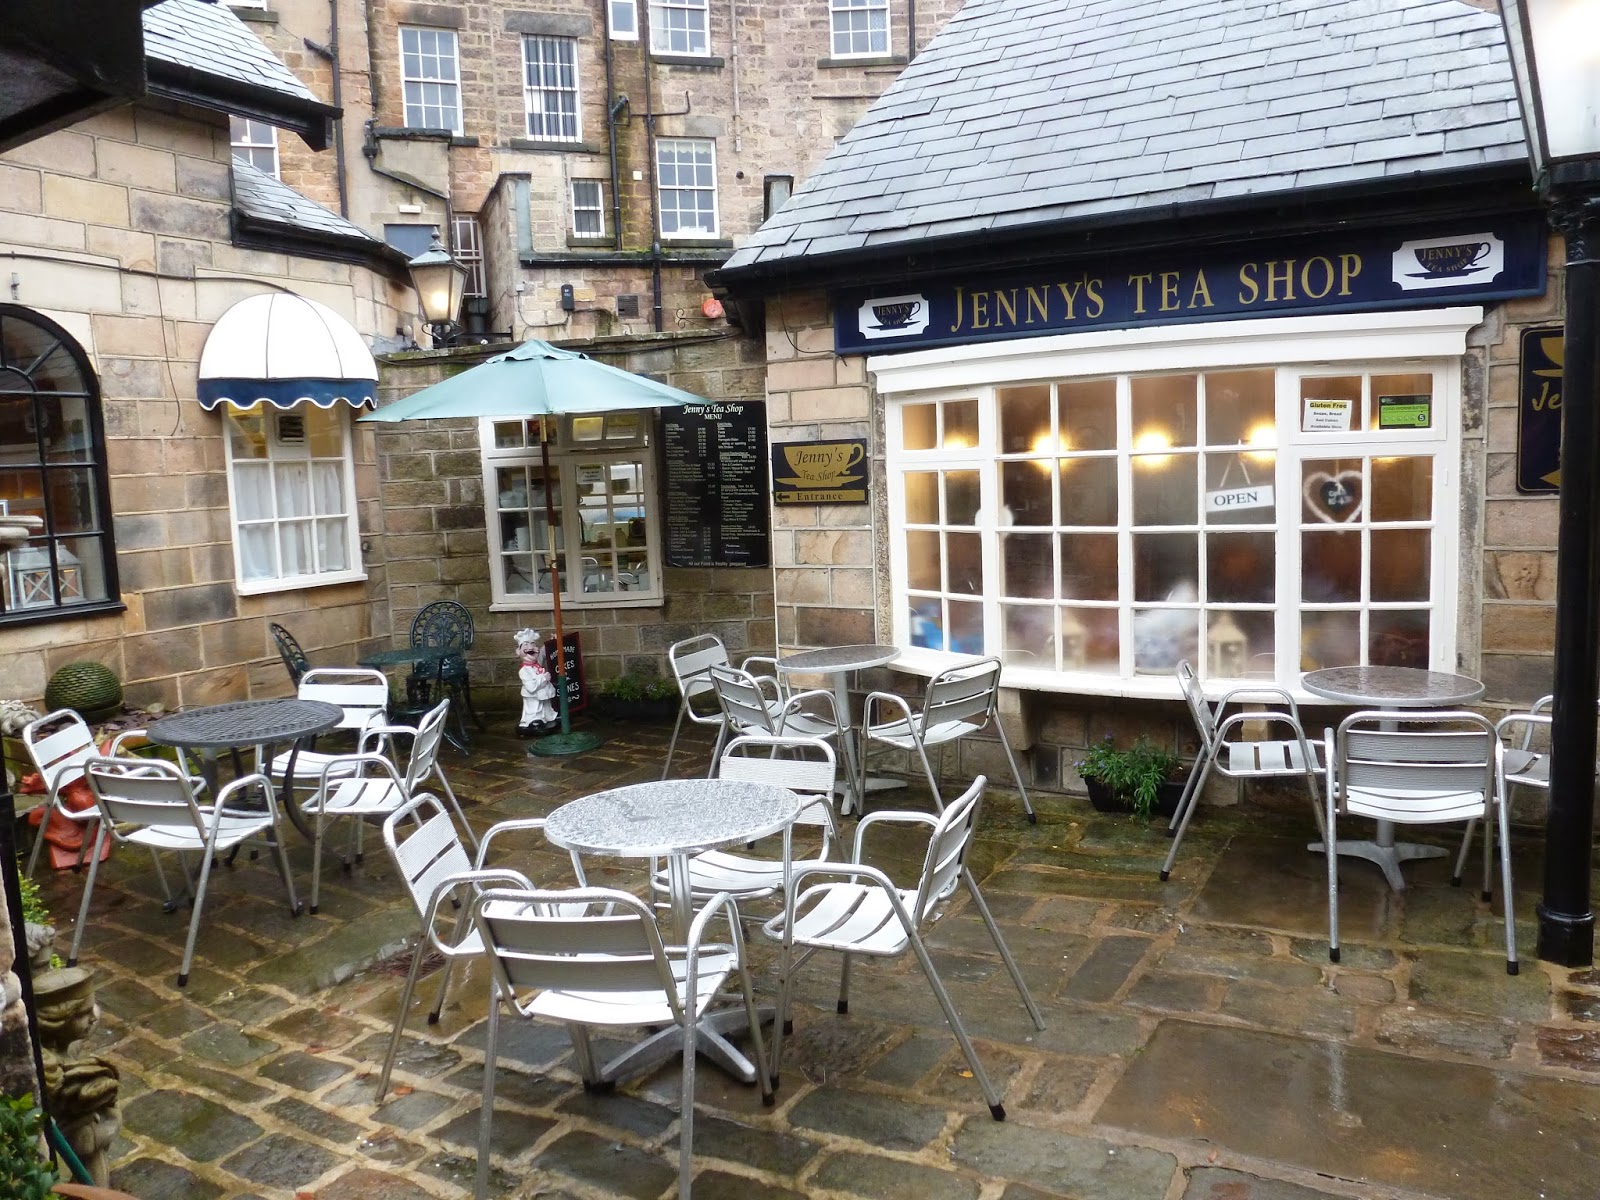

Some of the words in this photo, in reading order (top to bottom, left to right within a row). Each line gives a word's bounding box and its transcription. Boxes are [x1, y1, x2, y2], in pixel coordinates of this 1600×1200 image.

[1421, 245, 1473, 261] JENNY'S
[951, 272, 1104, 333] JENNY'S
[1128, 268, 1215, 314] TEA
[1238, 253, 1363, 305] SHOP
[877, 304, 910, 316] JENNY'S
[1531, 381, 1563, 411] Je
[683, 404, 710, 416] Jenny's
[711, 404, 724, 413] Tea
[725, 403, 744, 416] Shop
[794, 446, 844, 468] Jenny's
[802, 469, 815, 481] Tea
[816, 469, 836, 482] Shop
[797, 492, 844, 501] Entrance
[1214, 491, 1258, 506] OPEN
[555, 659, 575, 674] CKES
[556, 681, 580, 697] SNES
